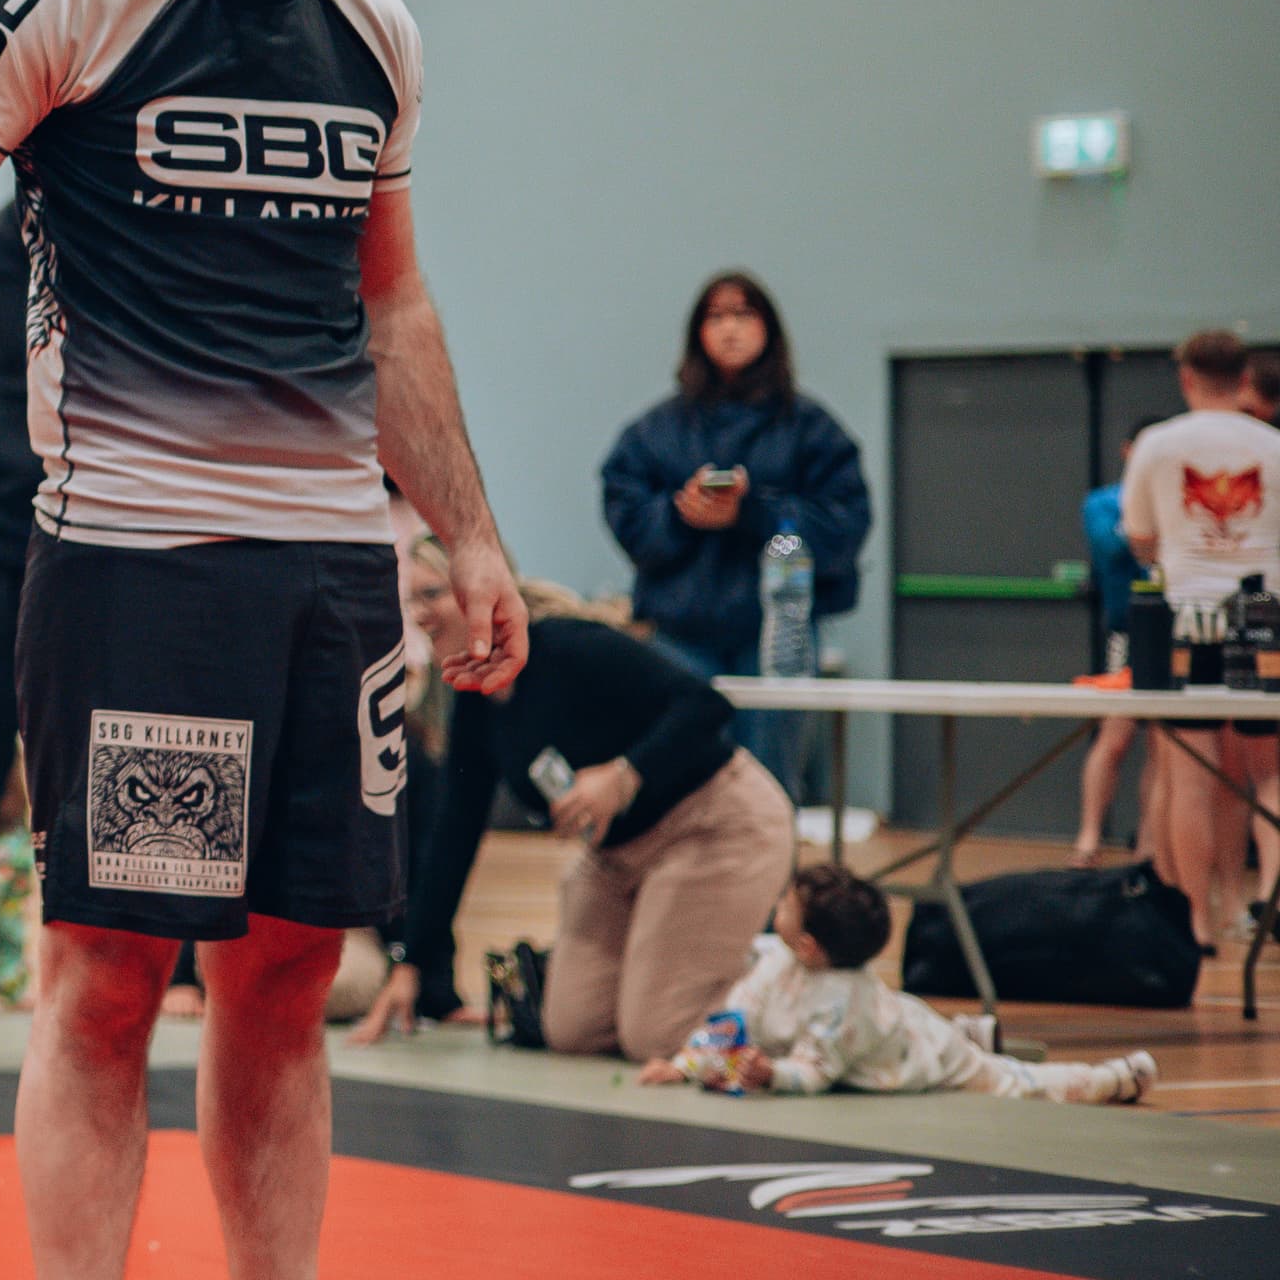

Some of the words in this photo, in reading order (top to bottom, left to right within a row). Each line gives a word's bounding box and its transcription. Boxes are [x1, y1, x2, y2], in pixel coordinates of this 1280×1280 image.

[152, 110, 380, 181] SBG
[98, 722, 133, 741] SBG
[145, 725, 245, 749] KILLARNEY
